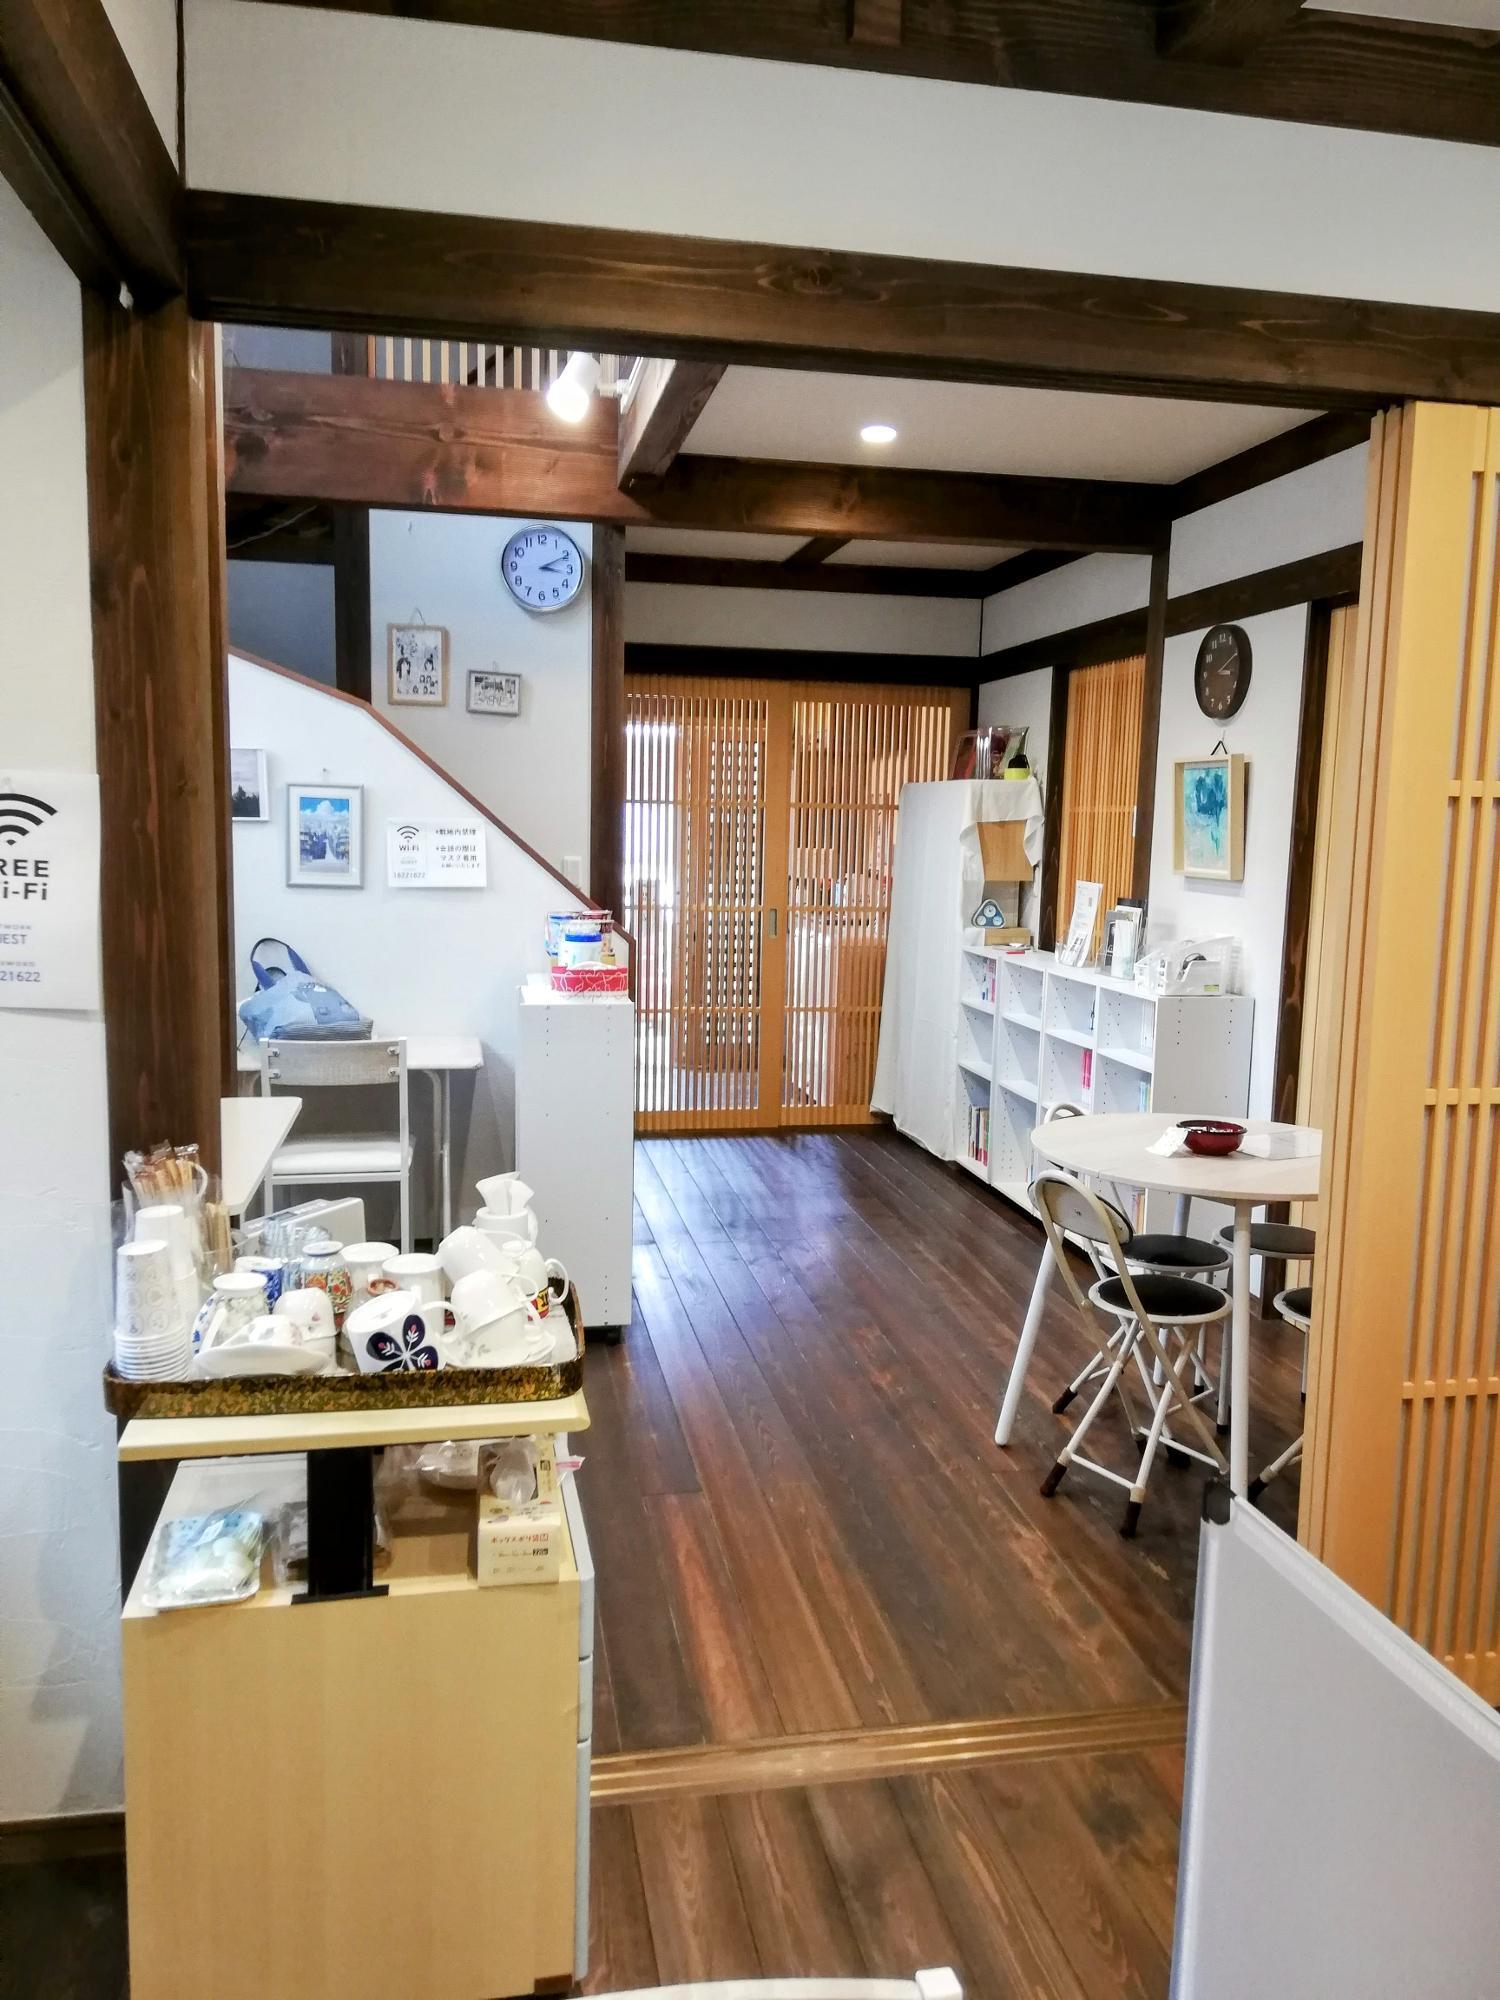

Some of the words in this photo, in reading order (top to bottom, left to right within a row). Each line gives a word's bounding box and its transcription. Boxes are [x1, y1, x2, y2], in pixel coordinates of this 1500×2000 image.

[525, 536, 533, 548] 11
[537, 534, 547, 545] 12
[514, 546, 525, 558] 10
[562, 550, 569, 560] 2
[510, 561, 518, 572] 9
[566, 564, 573, 575] 3
[515, 575, 522, 586] 8
[561, 579, 569, 589] 4
[524, 586, 532, 597] 7
[538, 591, 546, 601] 6
[552, 587, 560, 598] 5
[0, 880, 48, 900] i-Fi
